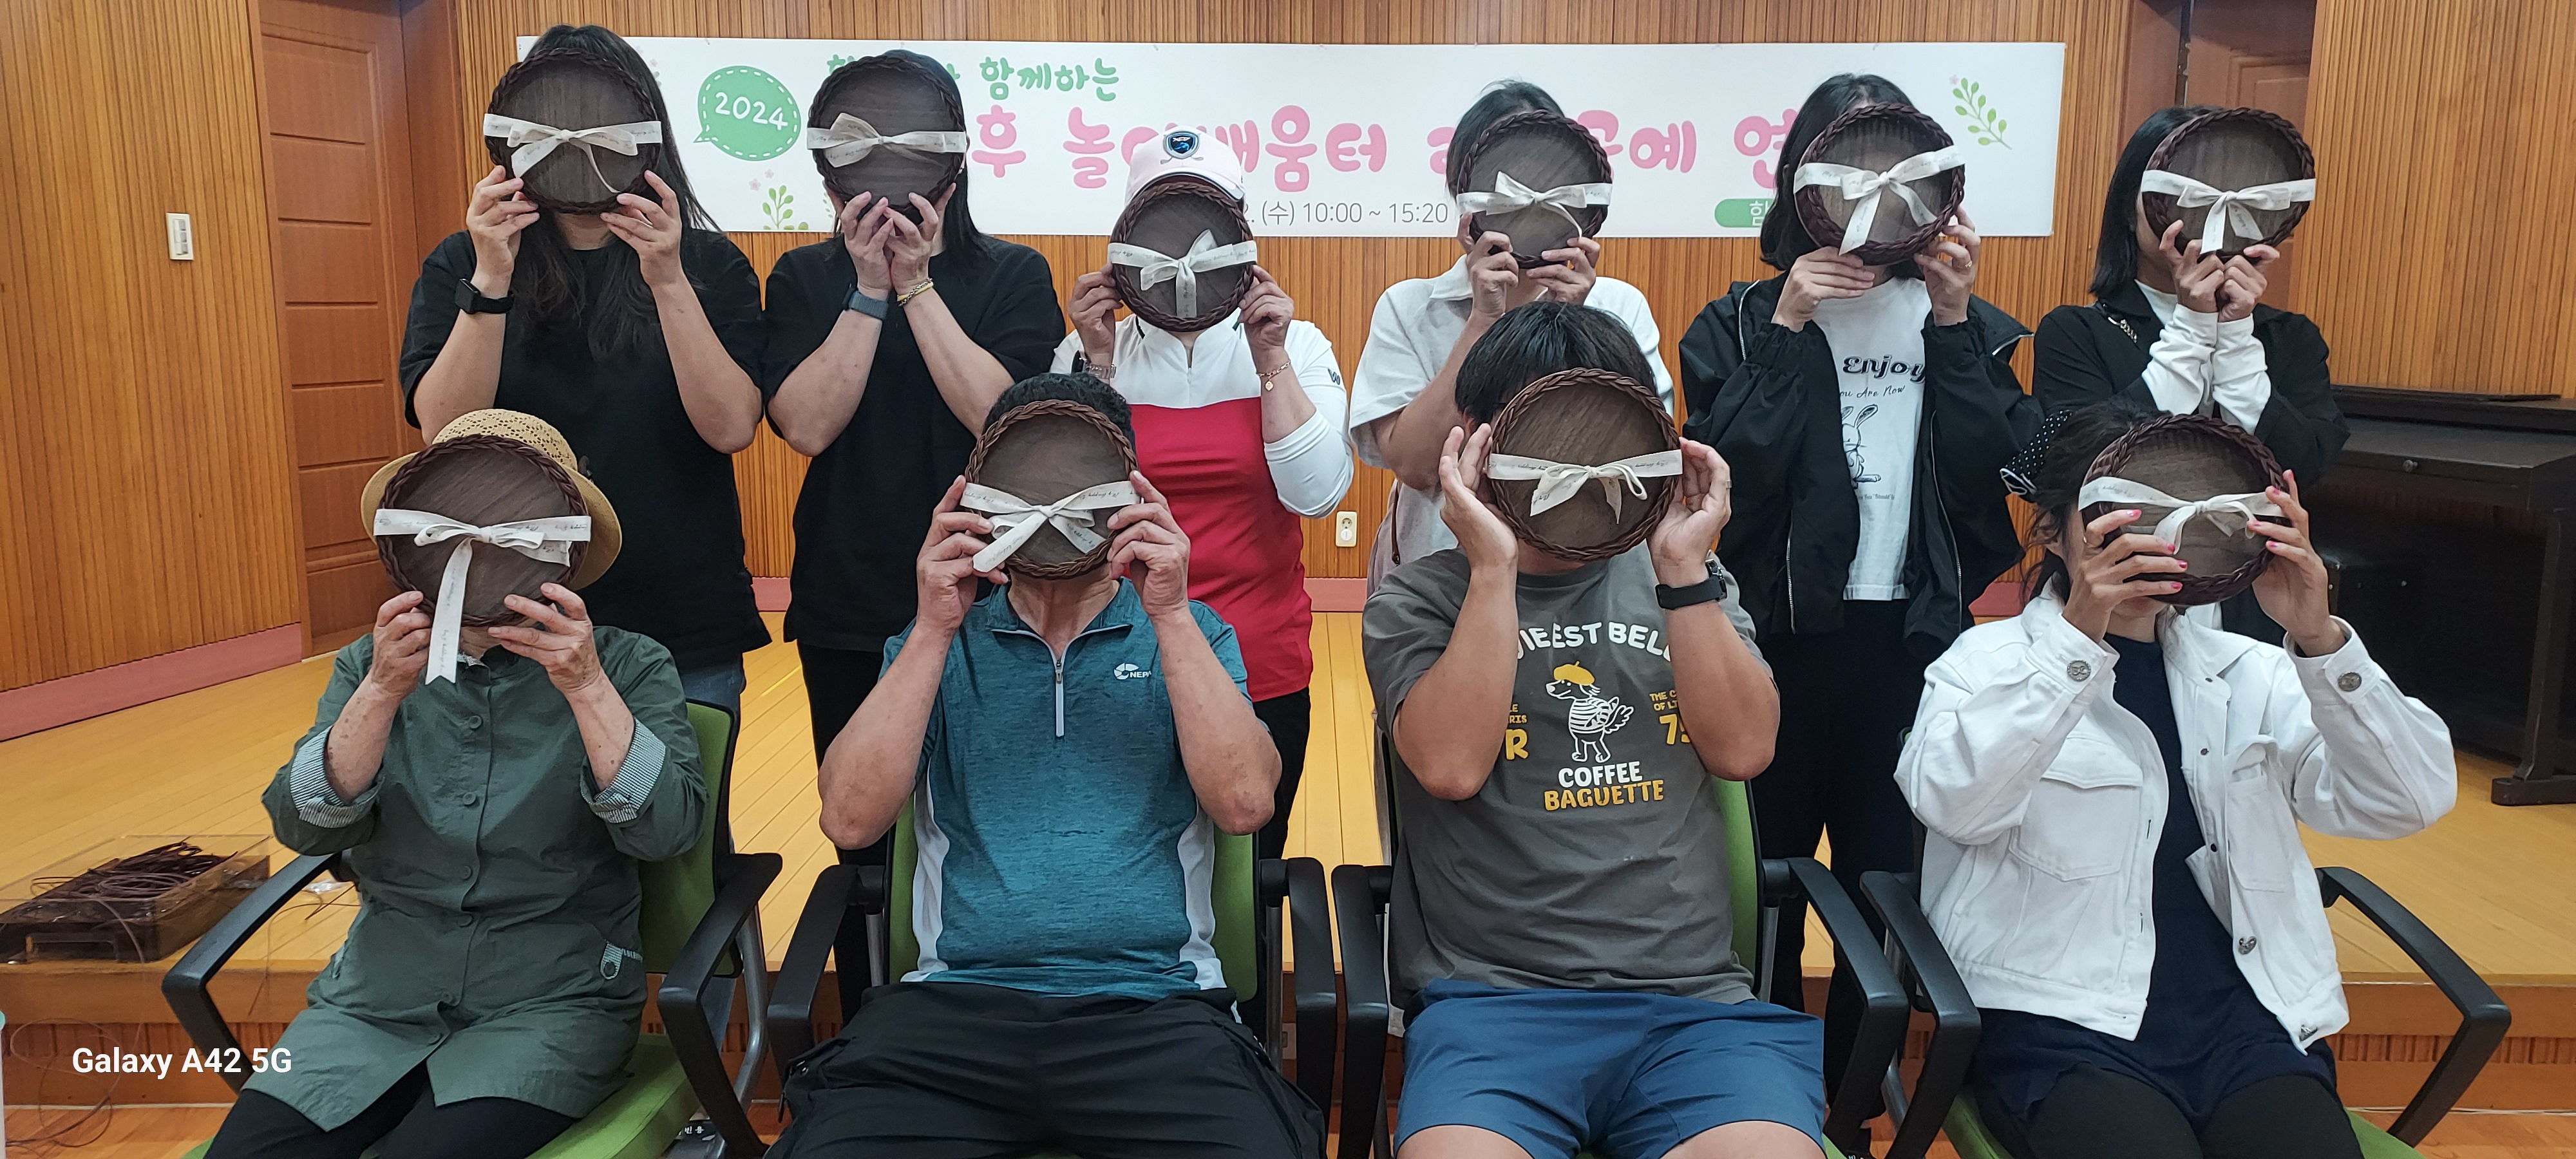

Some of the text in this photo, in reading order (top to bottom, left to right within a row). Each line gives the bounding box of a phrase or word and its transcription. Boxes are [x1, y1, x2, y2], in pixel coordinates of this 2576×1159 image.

[980, 56, 1119, 102] 함께하는
[715, 92, 789, 131] 2024
[1262, 200, 1295, 226] (수)
[1302, 202, 1363, 223] 10:00
[1388, 203, 1448, 223] 15:20
[1842, 355, 1925, 384] Enjoy
[1856, 386, 1879, 398] Are
[1882, 385, 1906, 397] Now
[1649, 692, 1668, 702] THE
[1654, 702, 1665, 711] OF
[1558, 761, 1643, 788] COFFEE
[1544, 779, 1664, 811] BAGUETTE
